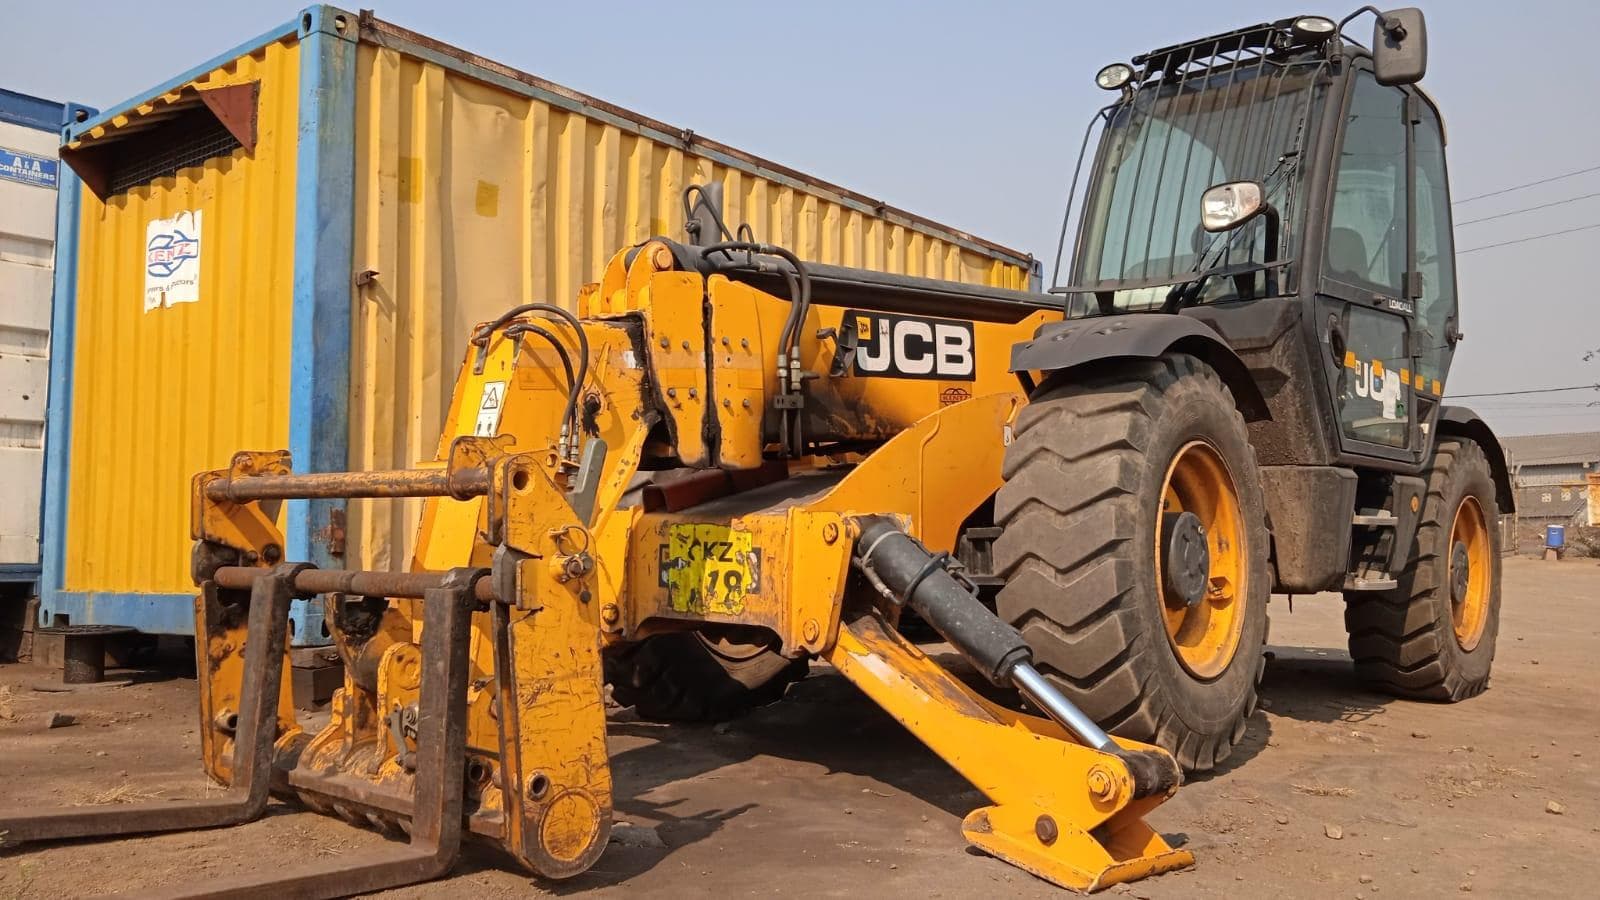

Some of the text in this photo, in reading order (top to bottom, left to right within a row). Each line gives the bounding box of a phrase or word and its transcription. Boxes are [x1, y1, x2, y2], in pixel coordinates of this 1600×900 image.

[13, 156, 22, 169] A
[32, 161, 40, 171] A
[1388, 299, 1413, 313] LOADALL
[856, 318, 973, 375] JCB
[1356, 361, 1391, 402] JC
